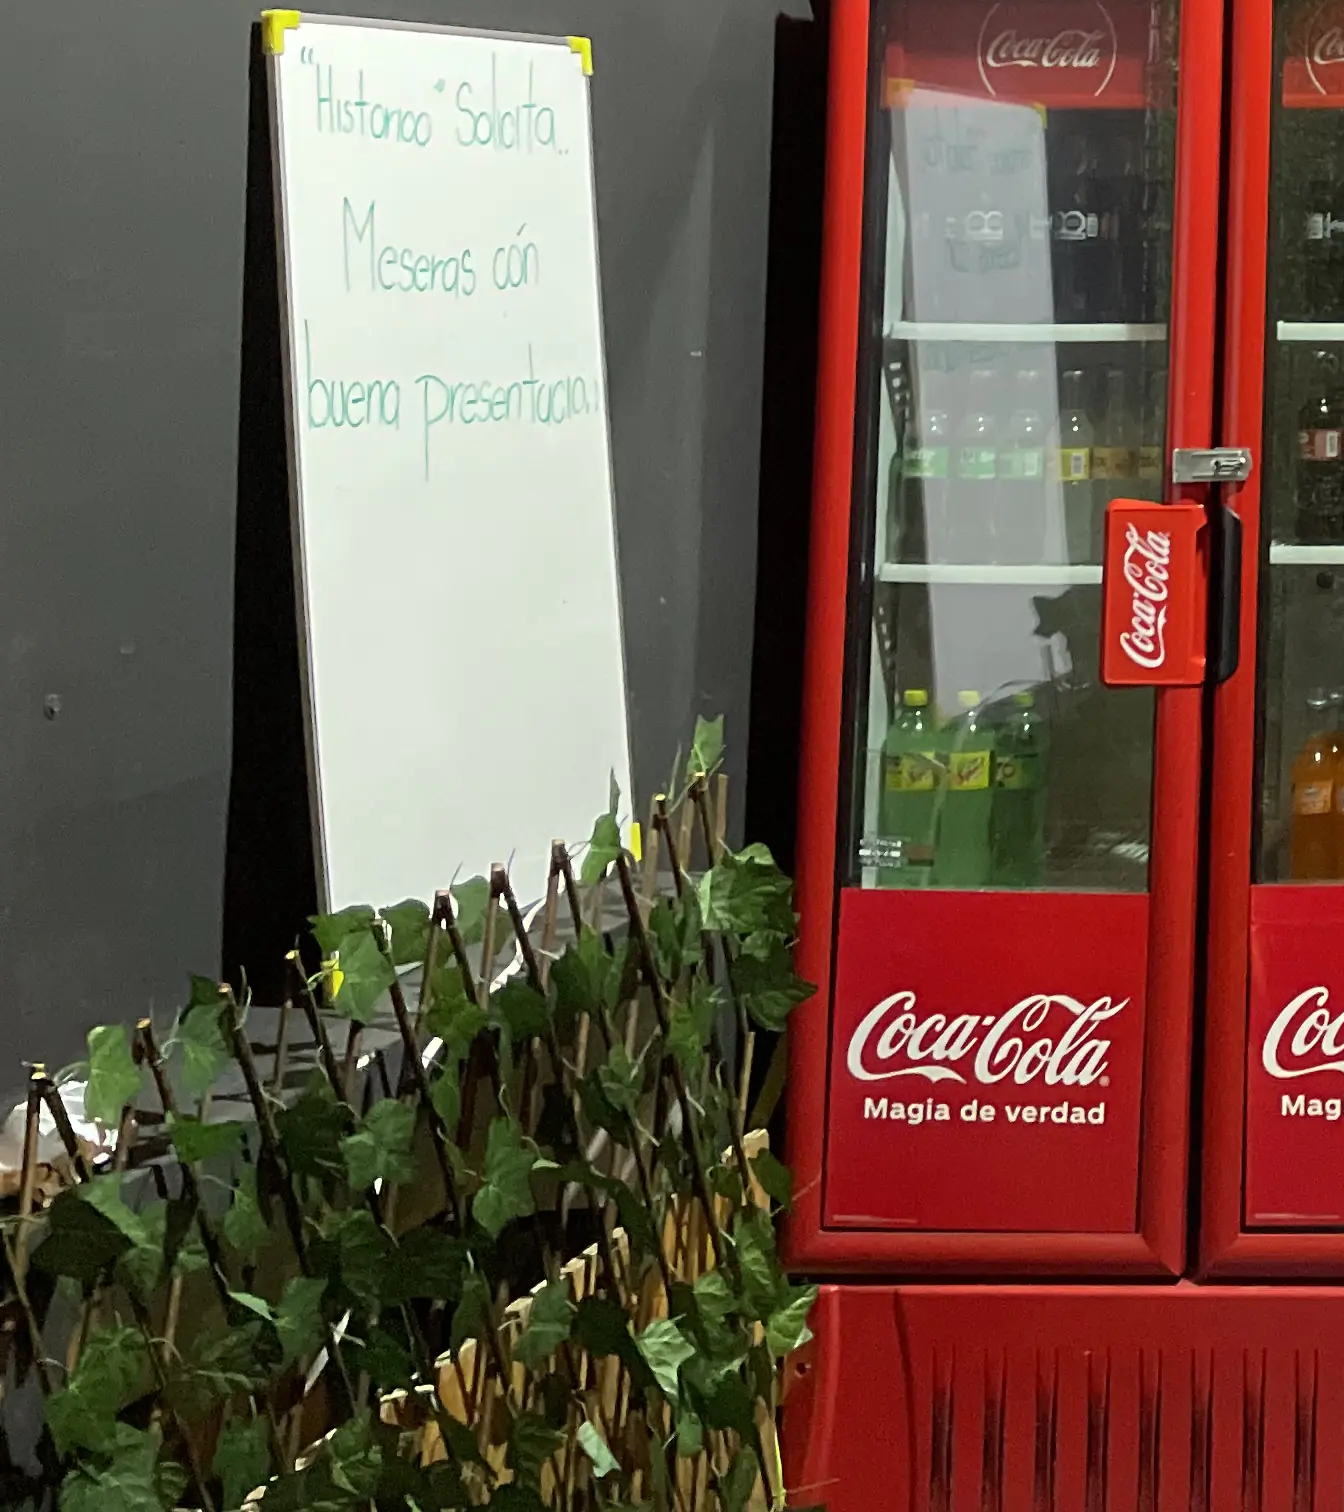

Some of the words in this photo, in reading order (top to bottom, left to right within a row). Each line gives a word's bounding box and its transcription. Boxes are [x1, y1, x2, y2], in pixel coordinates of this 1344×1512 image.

[303, 318, 401, 432] buena
[1119, 521, 1171, 669] Coca-Cola
[846, 990, 1131, 1088] Coca-Cola
[863, 1097, 951, 1125] Magia
[960, 1099, 997, 1123] de
[1004, 1101, 1106, 1125] verdad
